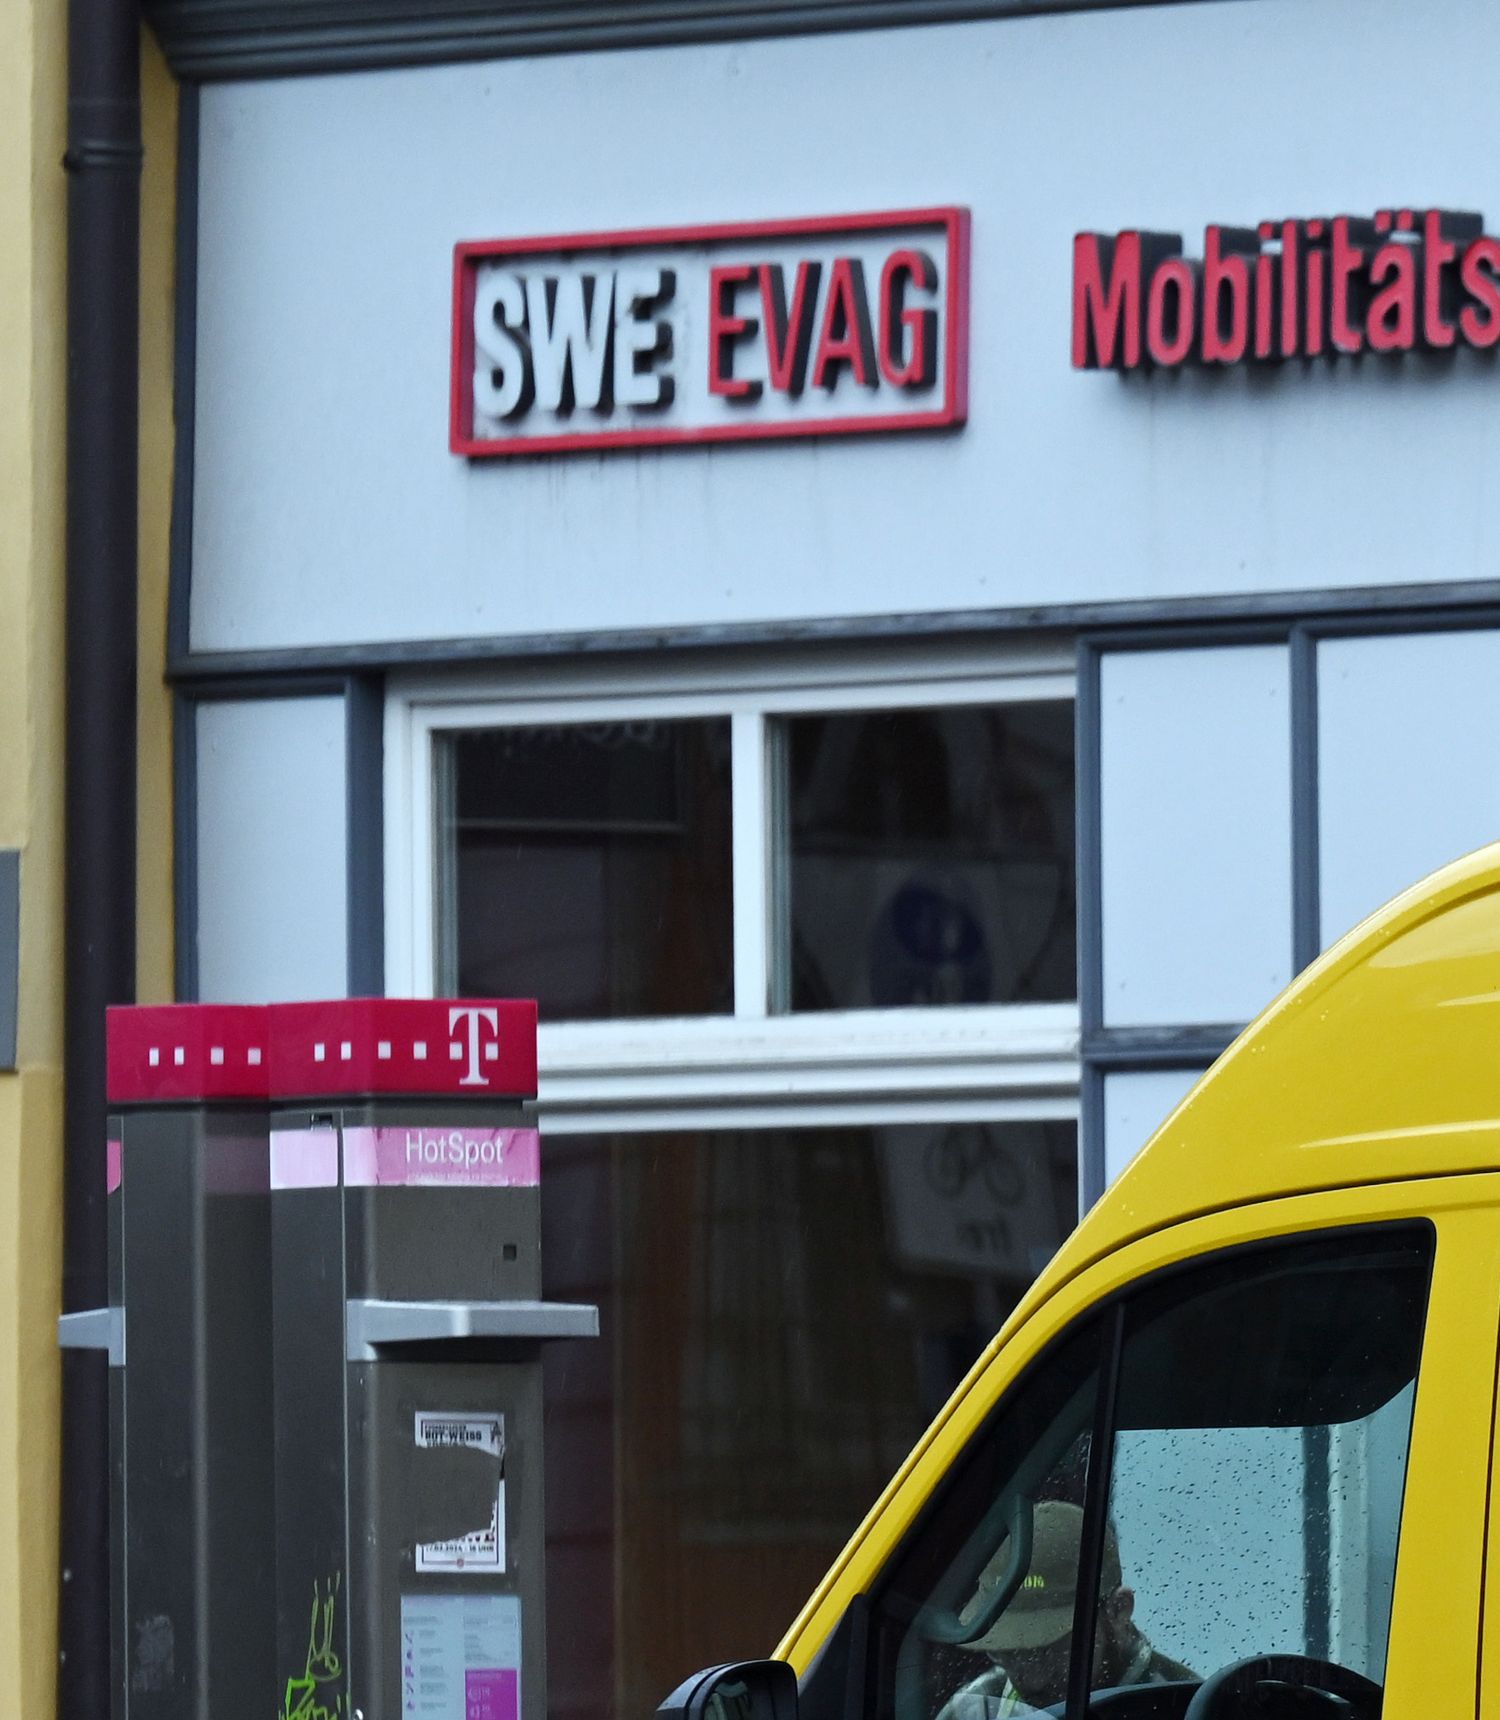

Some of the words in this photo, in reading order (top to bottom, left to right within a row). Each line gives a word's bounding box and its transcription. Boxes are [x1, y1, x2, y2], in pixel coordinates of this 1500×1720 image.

[472, 270, 674, 420] SWE
[708, 249, 937, 398] EVAG
[449, 1007, 499, 1085] T
[406, 1131, 503, 1169] HotSpot
